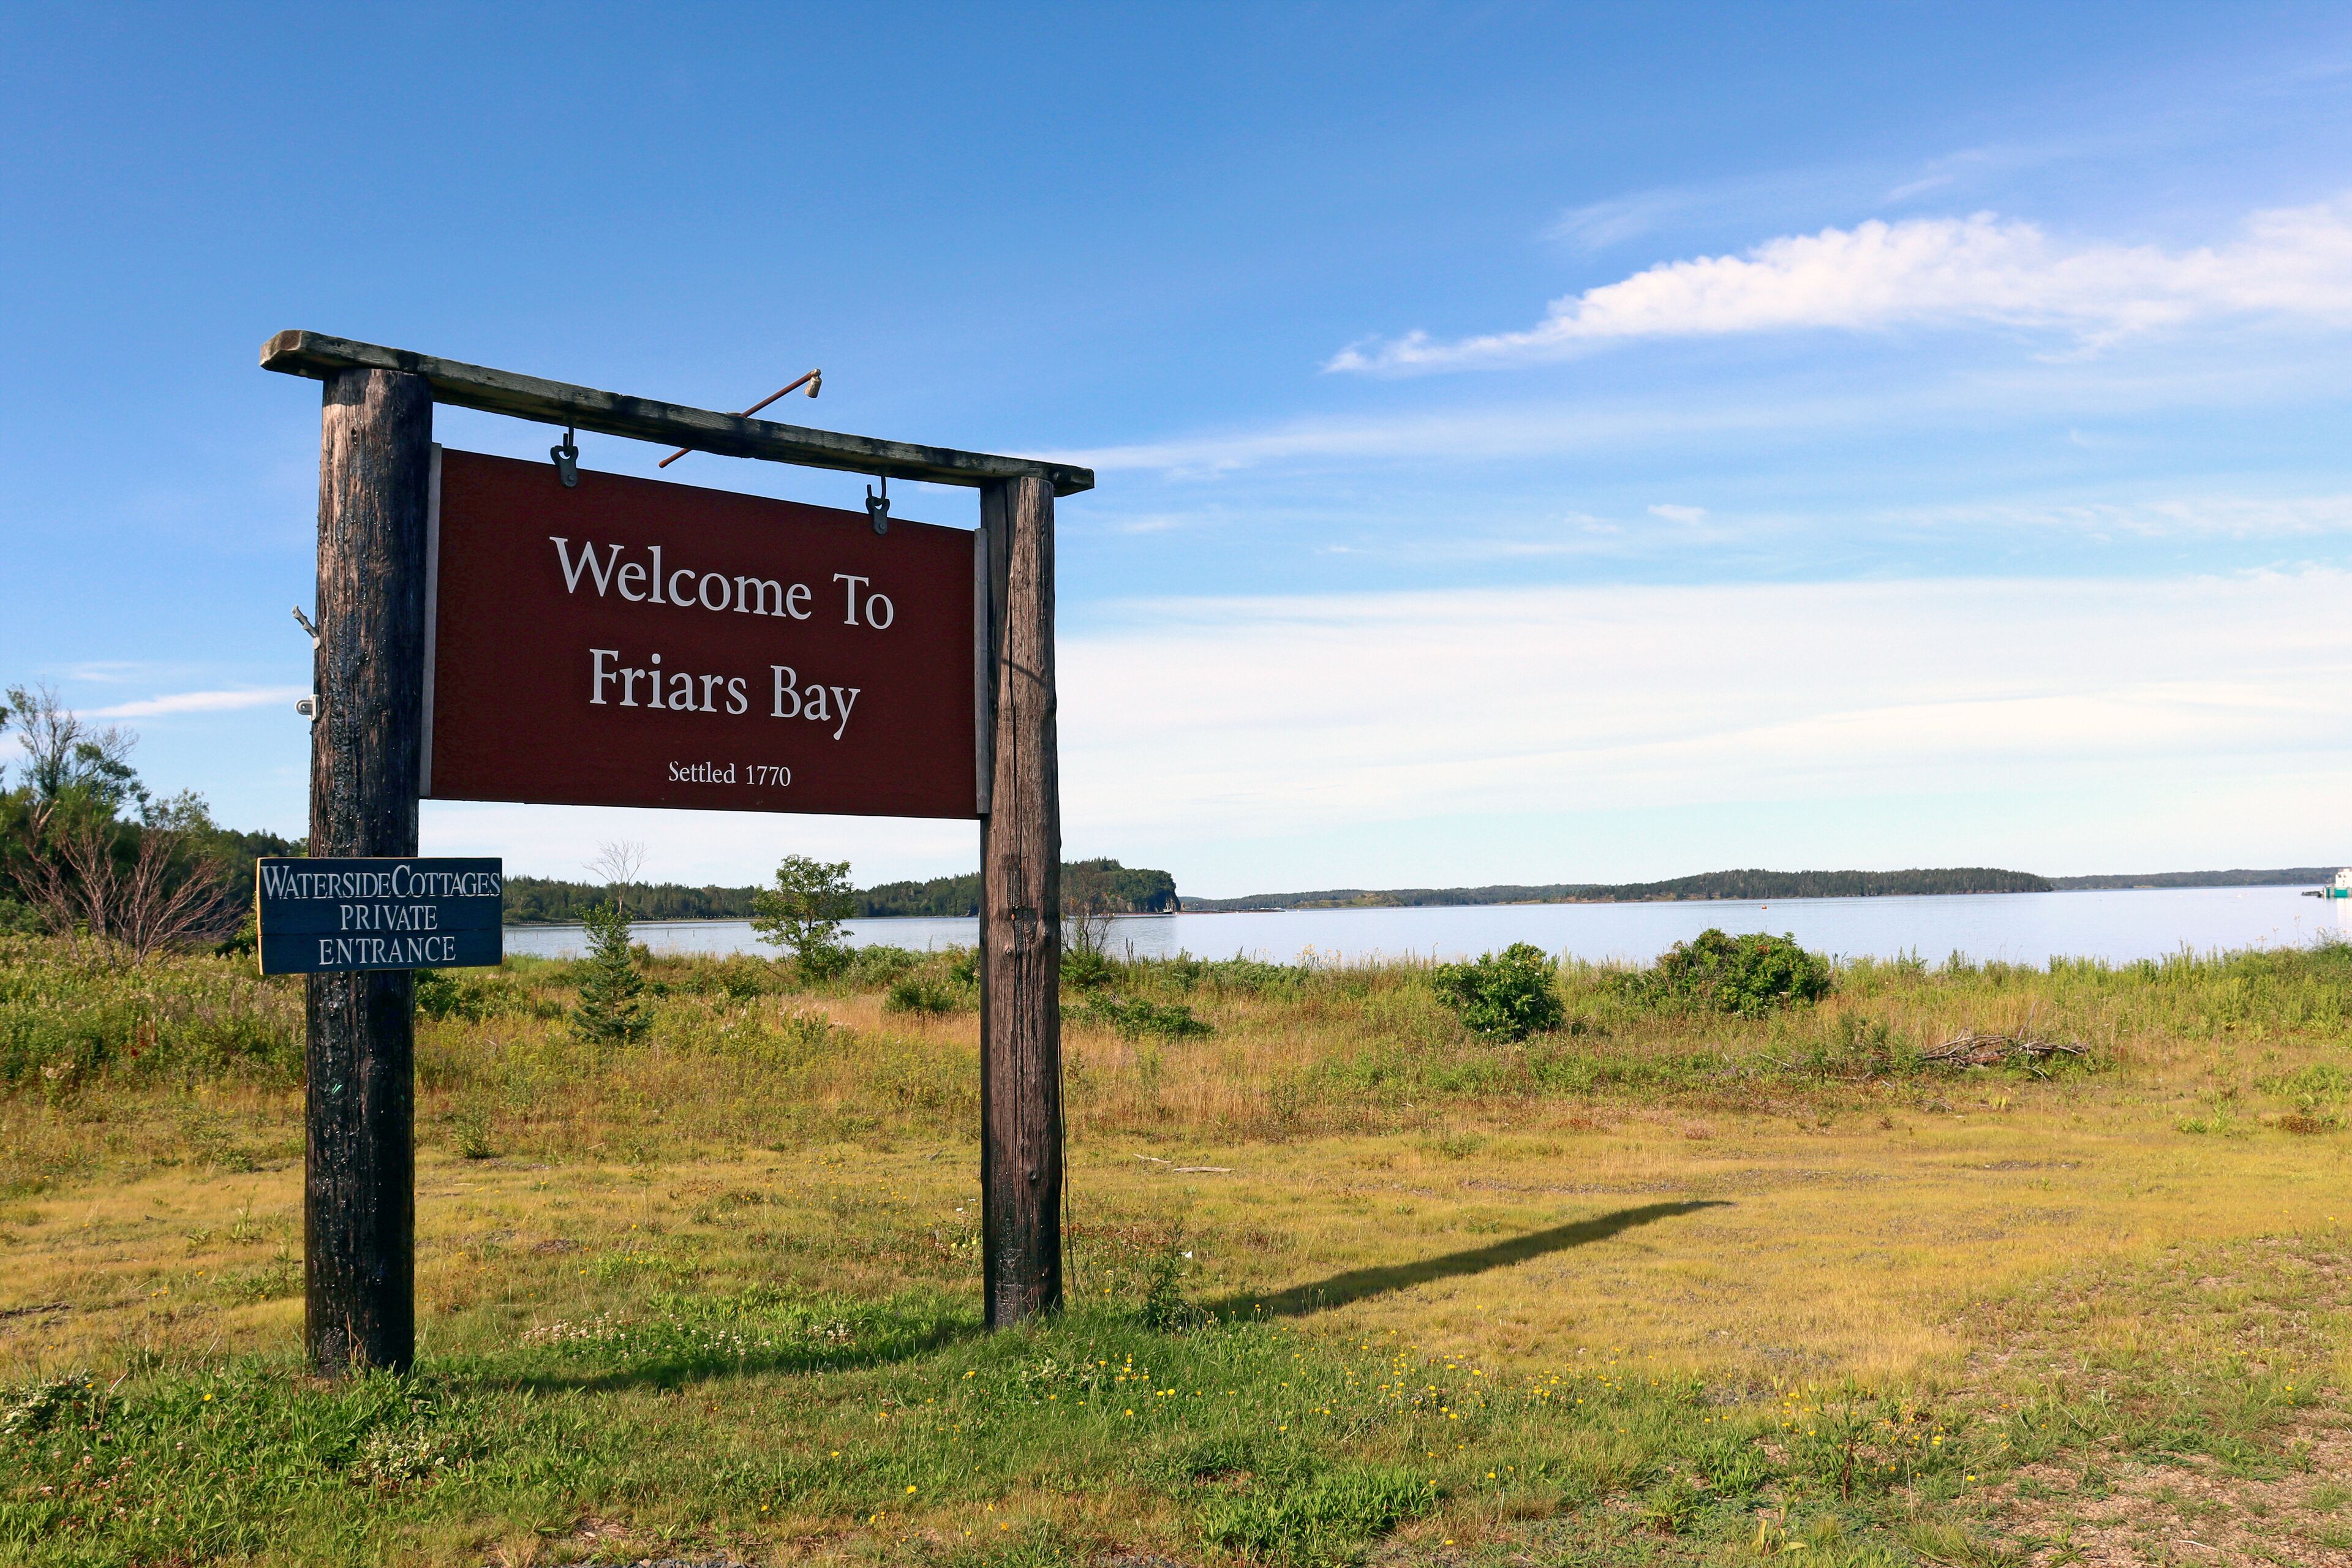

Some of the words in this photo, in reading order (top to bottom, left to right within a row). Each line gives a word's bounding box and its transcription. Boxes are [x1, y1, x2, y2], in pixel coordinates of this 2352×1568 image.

[549, 536, 812, 620] Welcome
[832, 573, 894, 630] To
[589, 649, 748, 715] Friars
[770, 665, 861, 741] Bay
[668, 761, 736, 784] Settled
[745, 764, 791, 786] 1770
[339, 905, 438, 931] PRIVATE
[318, 936, 456, 965] ENTRANCE
